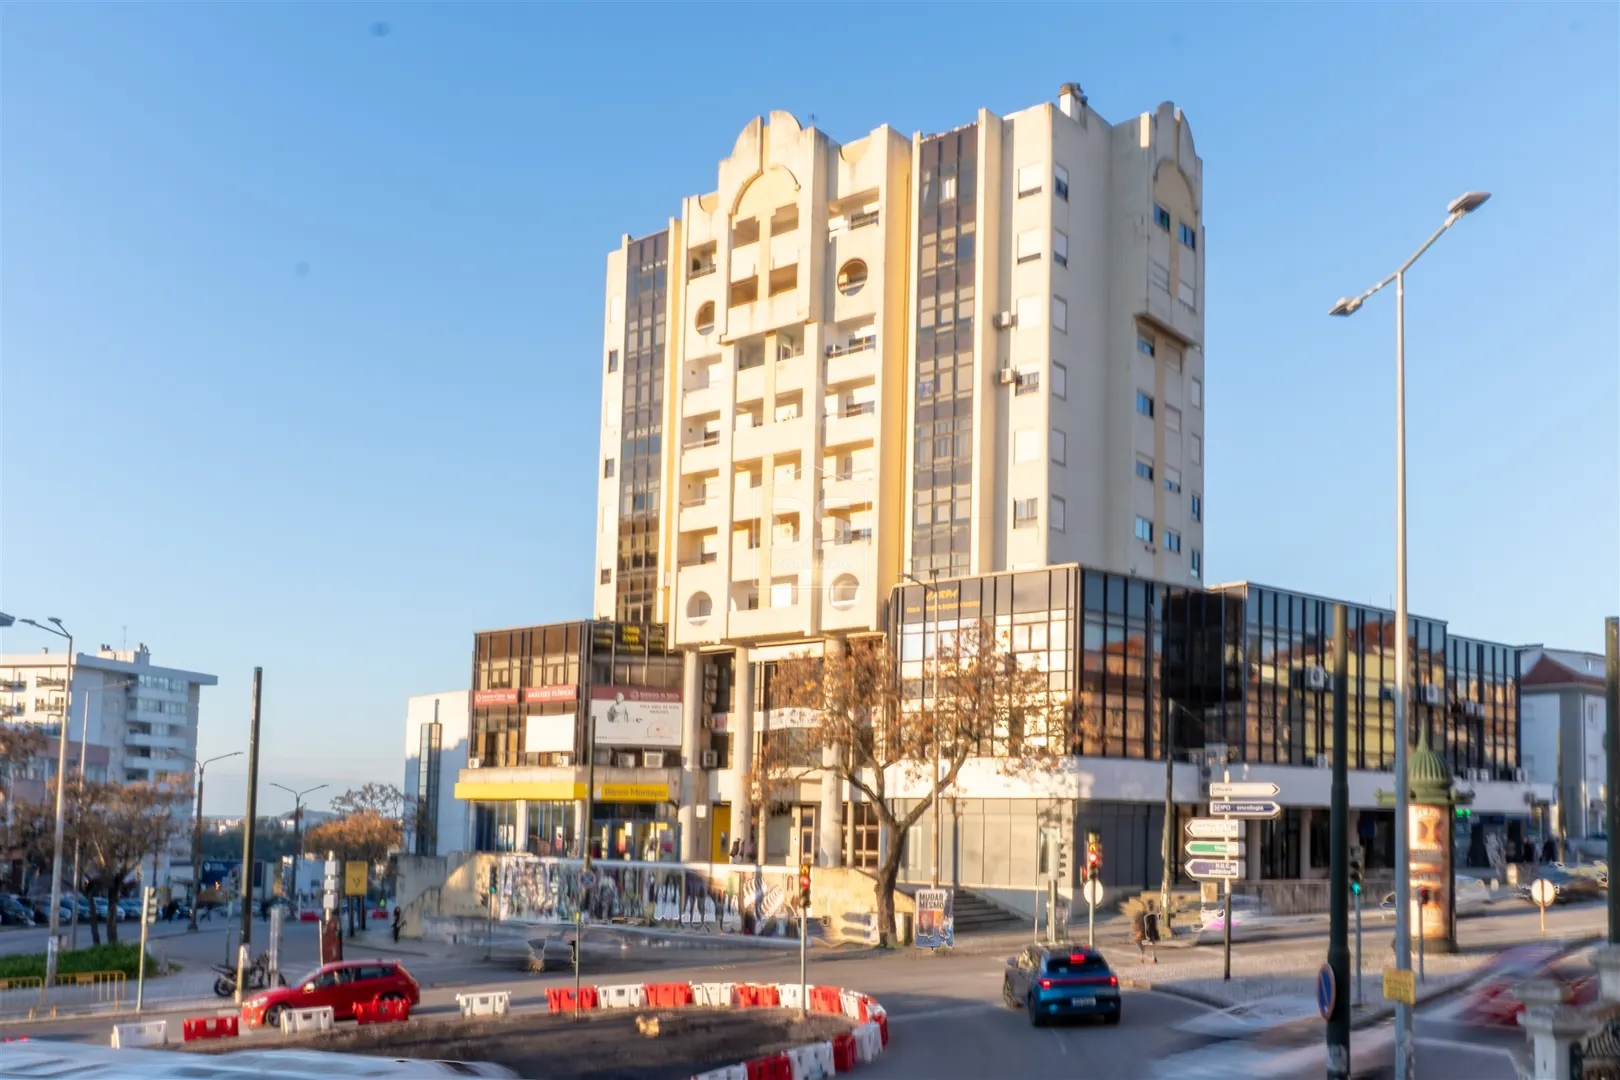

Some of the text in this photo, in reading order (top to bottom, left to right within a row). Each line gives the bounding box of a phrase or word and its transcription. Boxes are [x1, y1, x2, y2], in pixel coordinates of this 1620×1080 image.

[605, 788, 667, 798] Banco Montepio
[920, 892, 944, 901] MUDAR
[919, 900, 944, 909] MESMO
